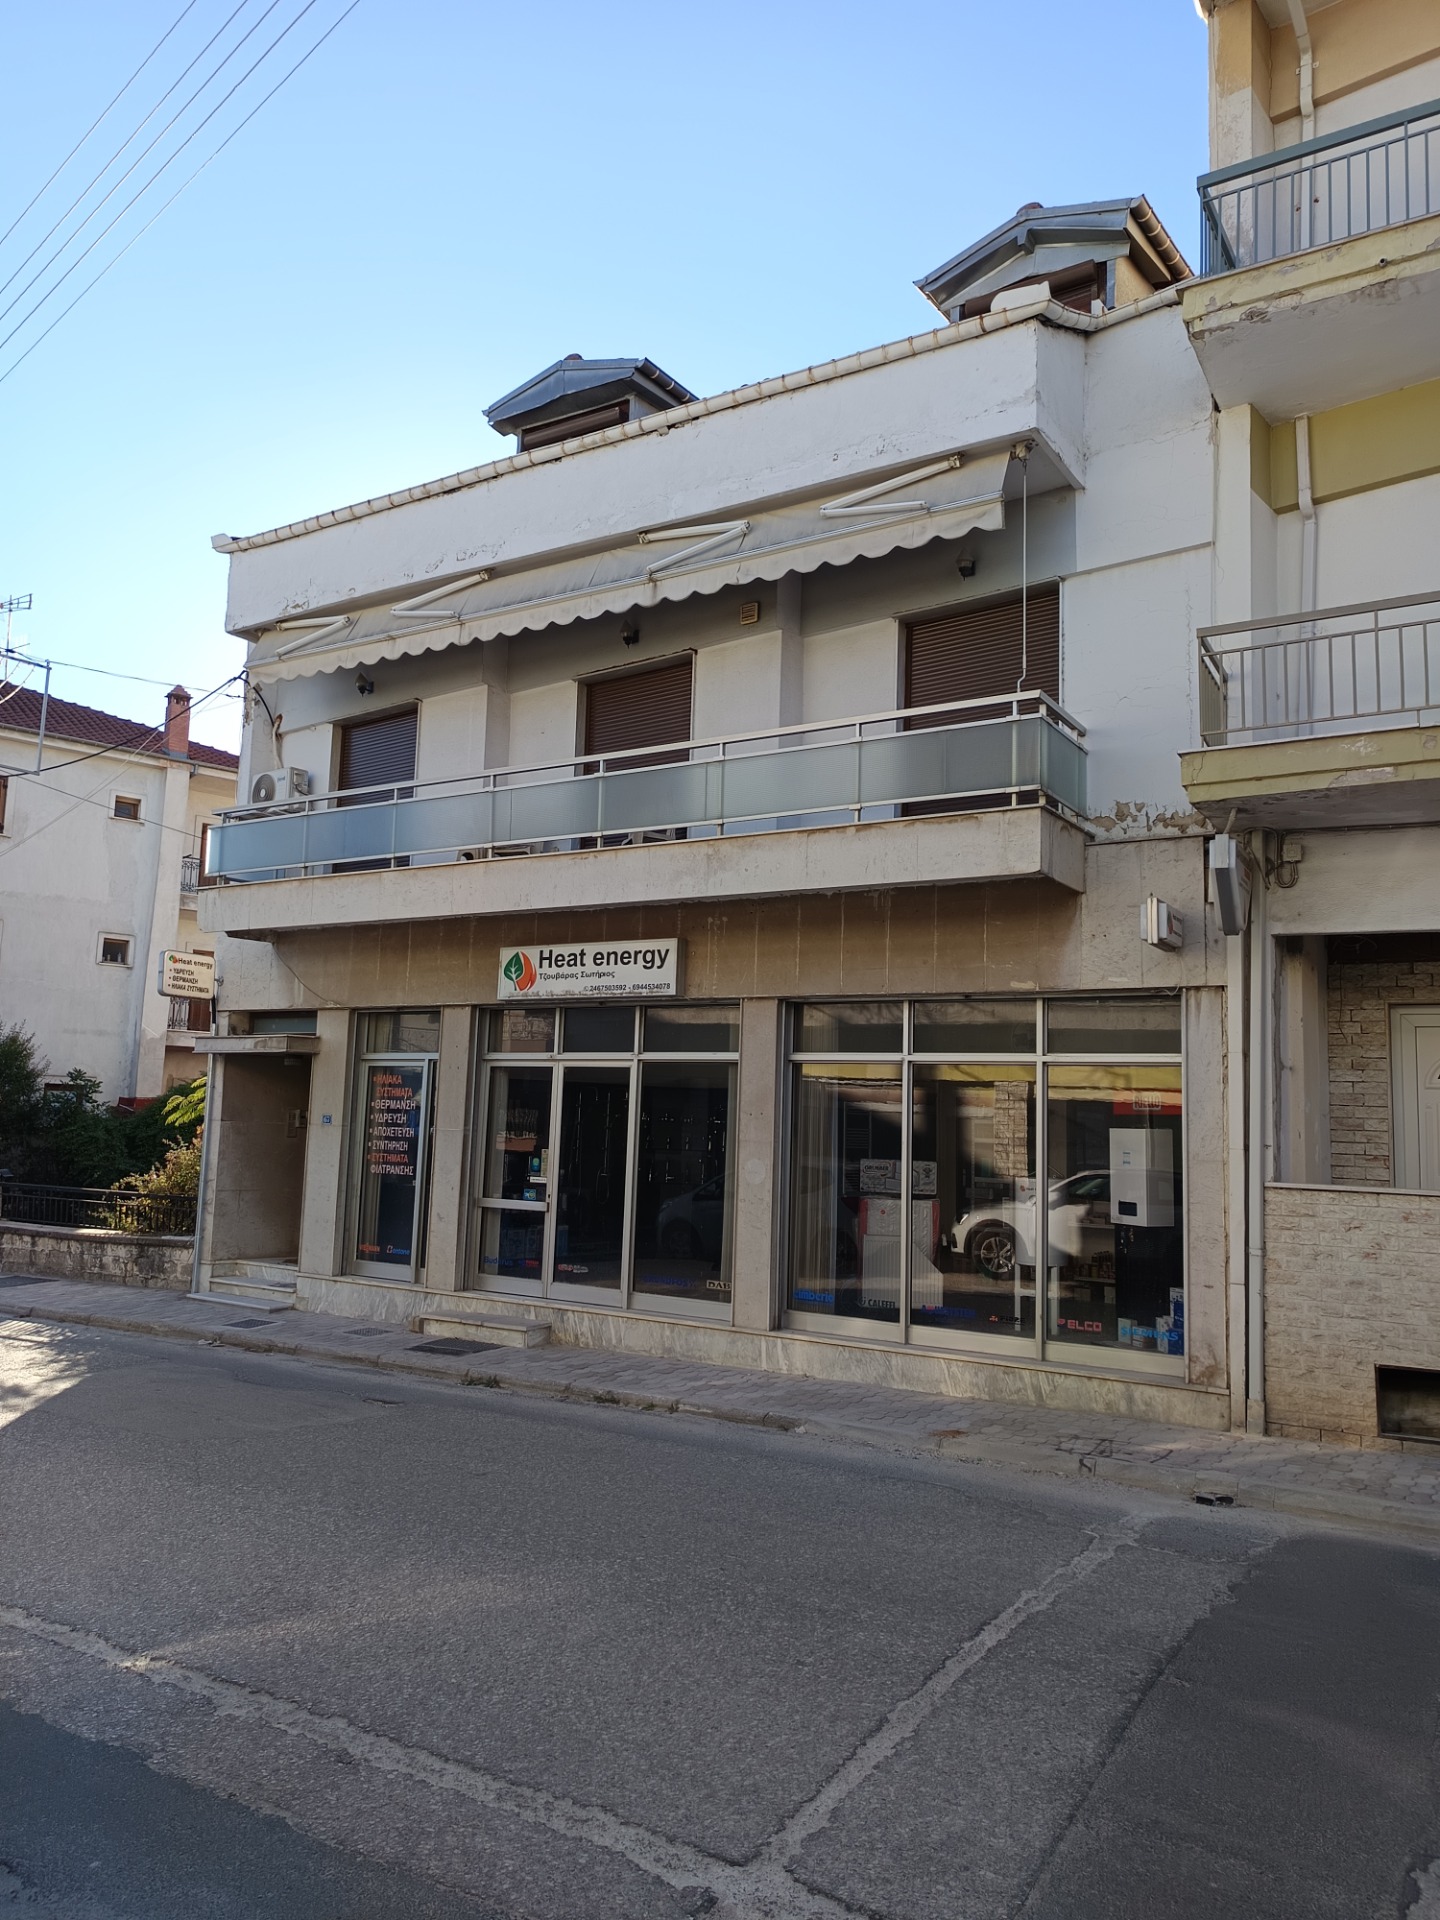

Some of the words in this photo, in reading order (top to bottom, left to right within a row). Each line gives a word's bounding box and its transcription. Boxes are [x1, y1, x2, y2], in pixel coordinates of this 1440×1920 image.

[539, 948, 586, 969] Heat
[592, 948, 670, 970] energy
[193, 961, 213, 970] energy
[539, 972, 579, 981] Τζουβάρας
[581, 970, 615, 979] Σωτήριος
[377, 1074, 402, 1085] ΗΛΙΑΚΑ
[376, 1087, 413, 1097] ΣΥΣΤΗΜΑΤΑ
[375, 1099, 416, 1110] ΘΕΡΜΑΝΣΗ
[1134, 1095, 1160, 1109] RIELLO
[374, 1112, 407, 1124] ΥΔΡΕΥΣΗ
[373, 1126, 415, 1138] ΑΠΟΧΕΤΕΥΣΗ
[372, 1140, 408, 1151] ΣΥΝΤΗΡΗΣΗ
[371, 1153, 409, 1163] ΣΥΣΤΗΜΑΤΑ
[370, 1164, 414, 1176] ΦΙΛΤΡΑΝΣΗΣ
[1067, 1319, 1102, 1333] ELCO
[1120, 1326, 1179, 1342] SIEMENS
